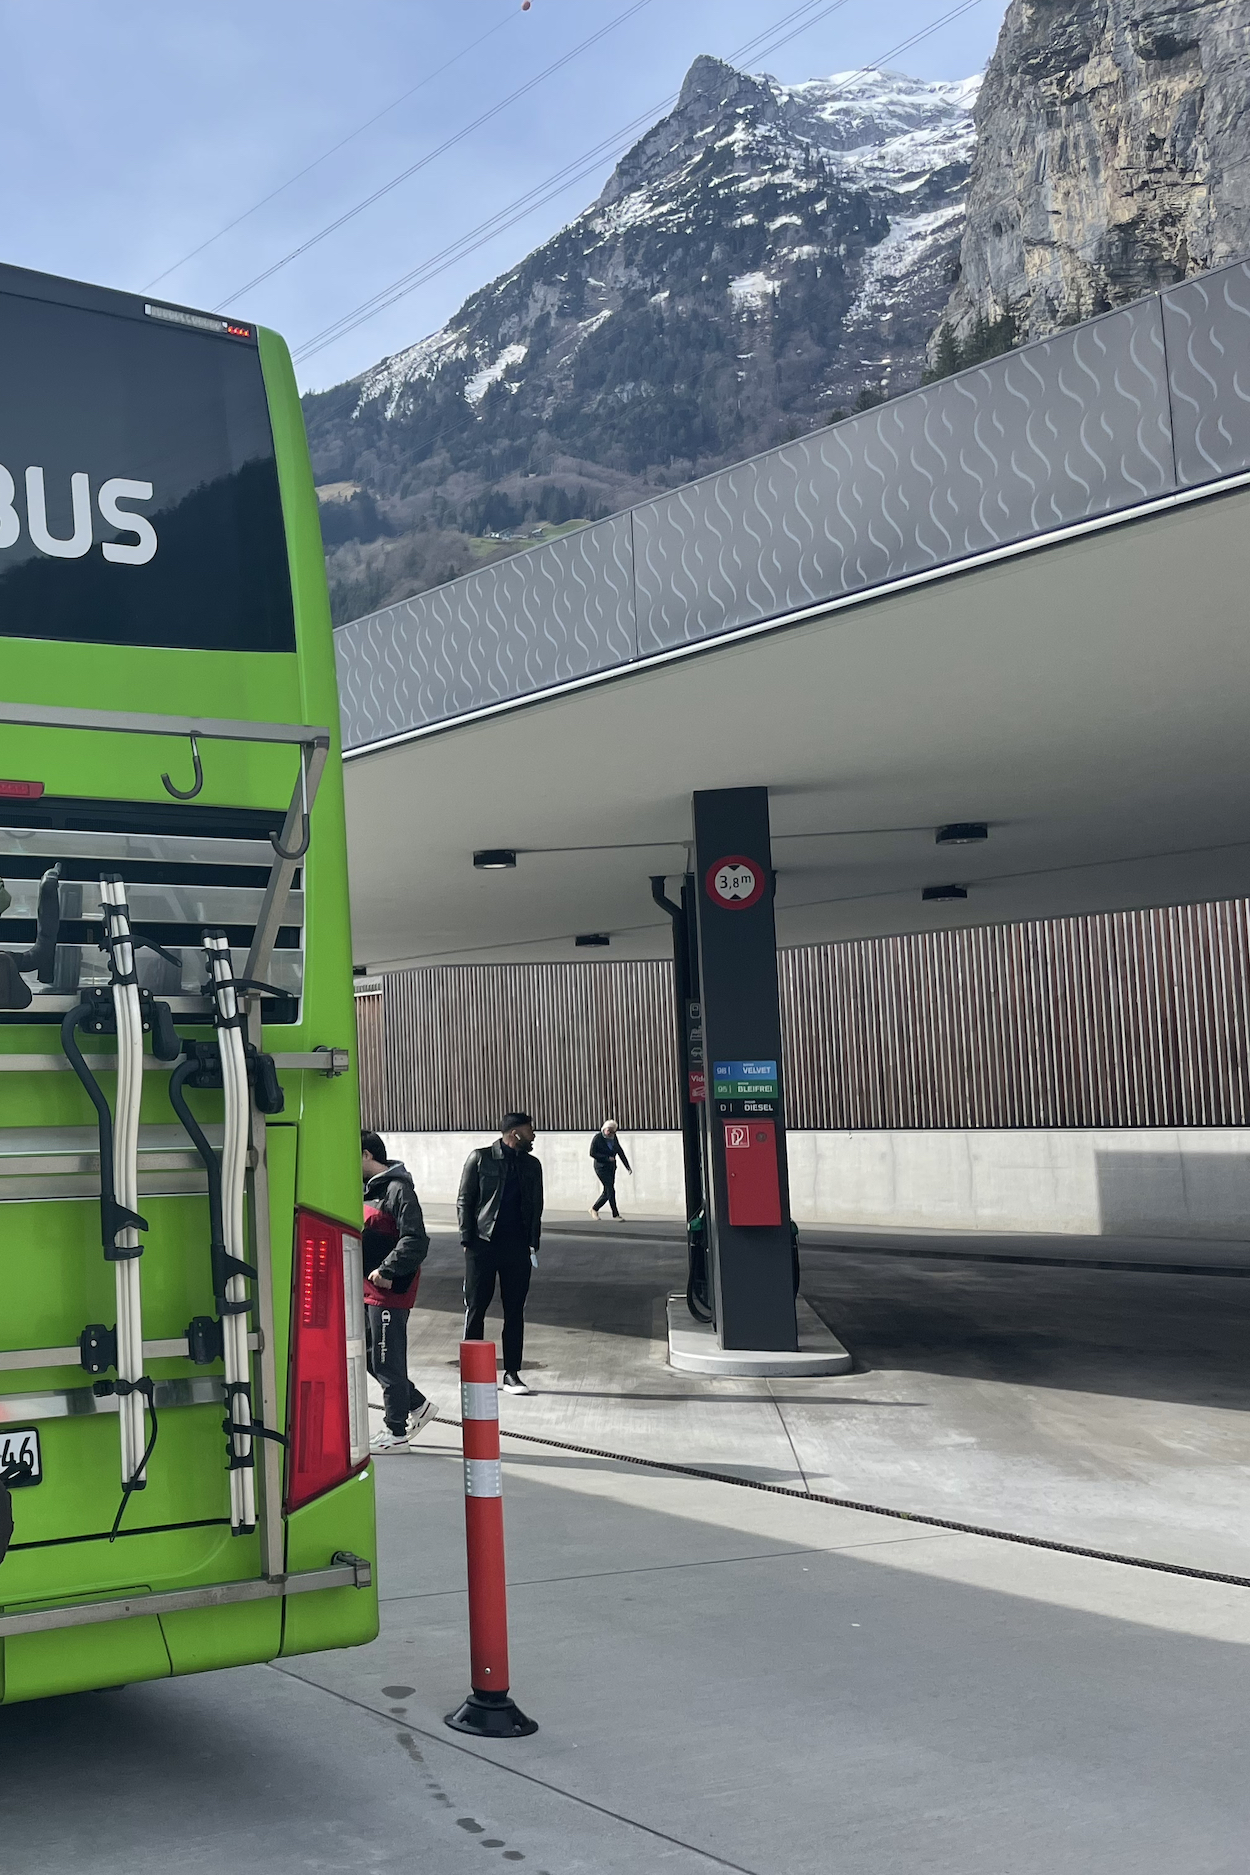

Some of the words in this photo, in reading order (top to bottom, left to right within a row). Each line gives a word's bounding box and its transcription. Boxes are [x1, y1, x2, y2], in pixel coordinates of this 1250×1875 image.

[742, 1066, 771, 1074] VELVET
[737, 1085, 773, 1093] BLEIFREI
[744, 1104, 774, 1112] DIESEL
